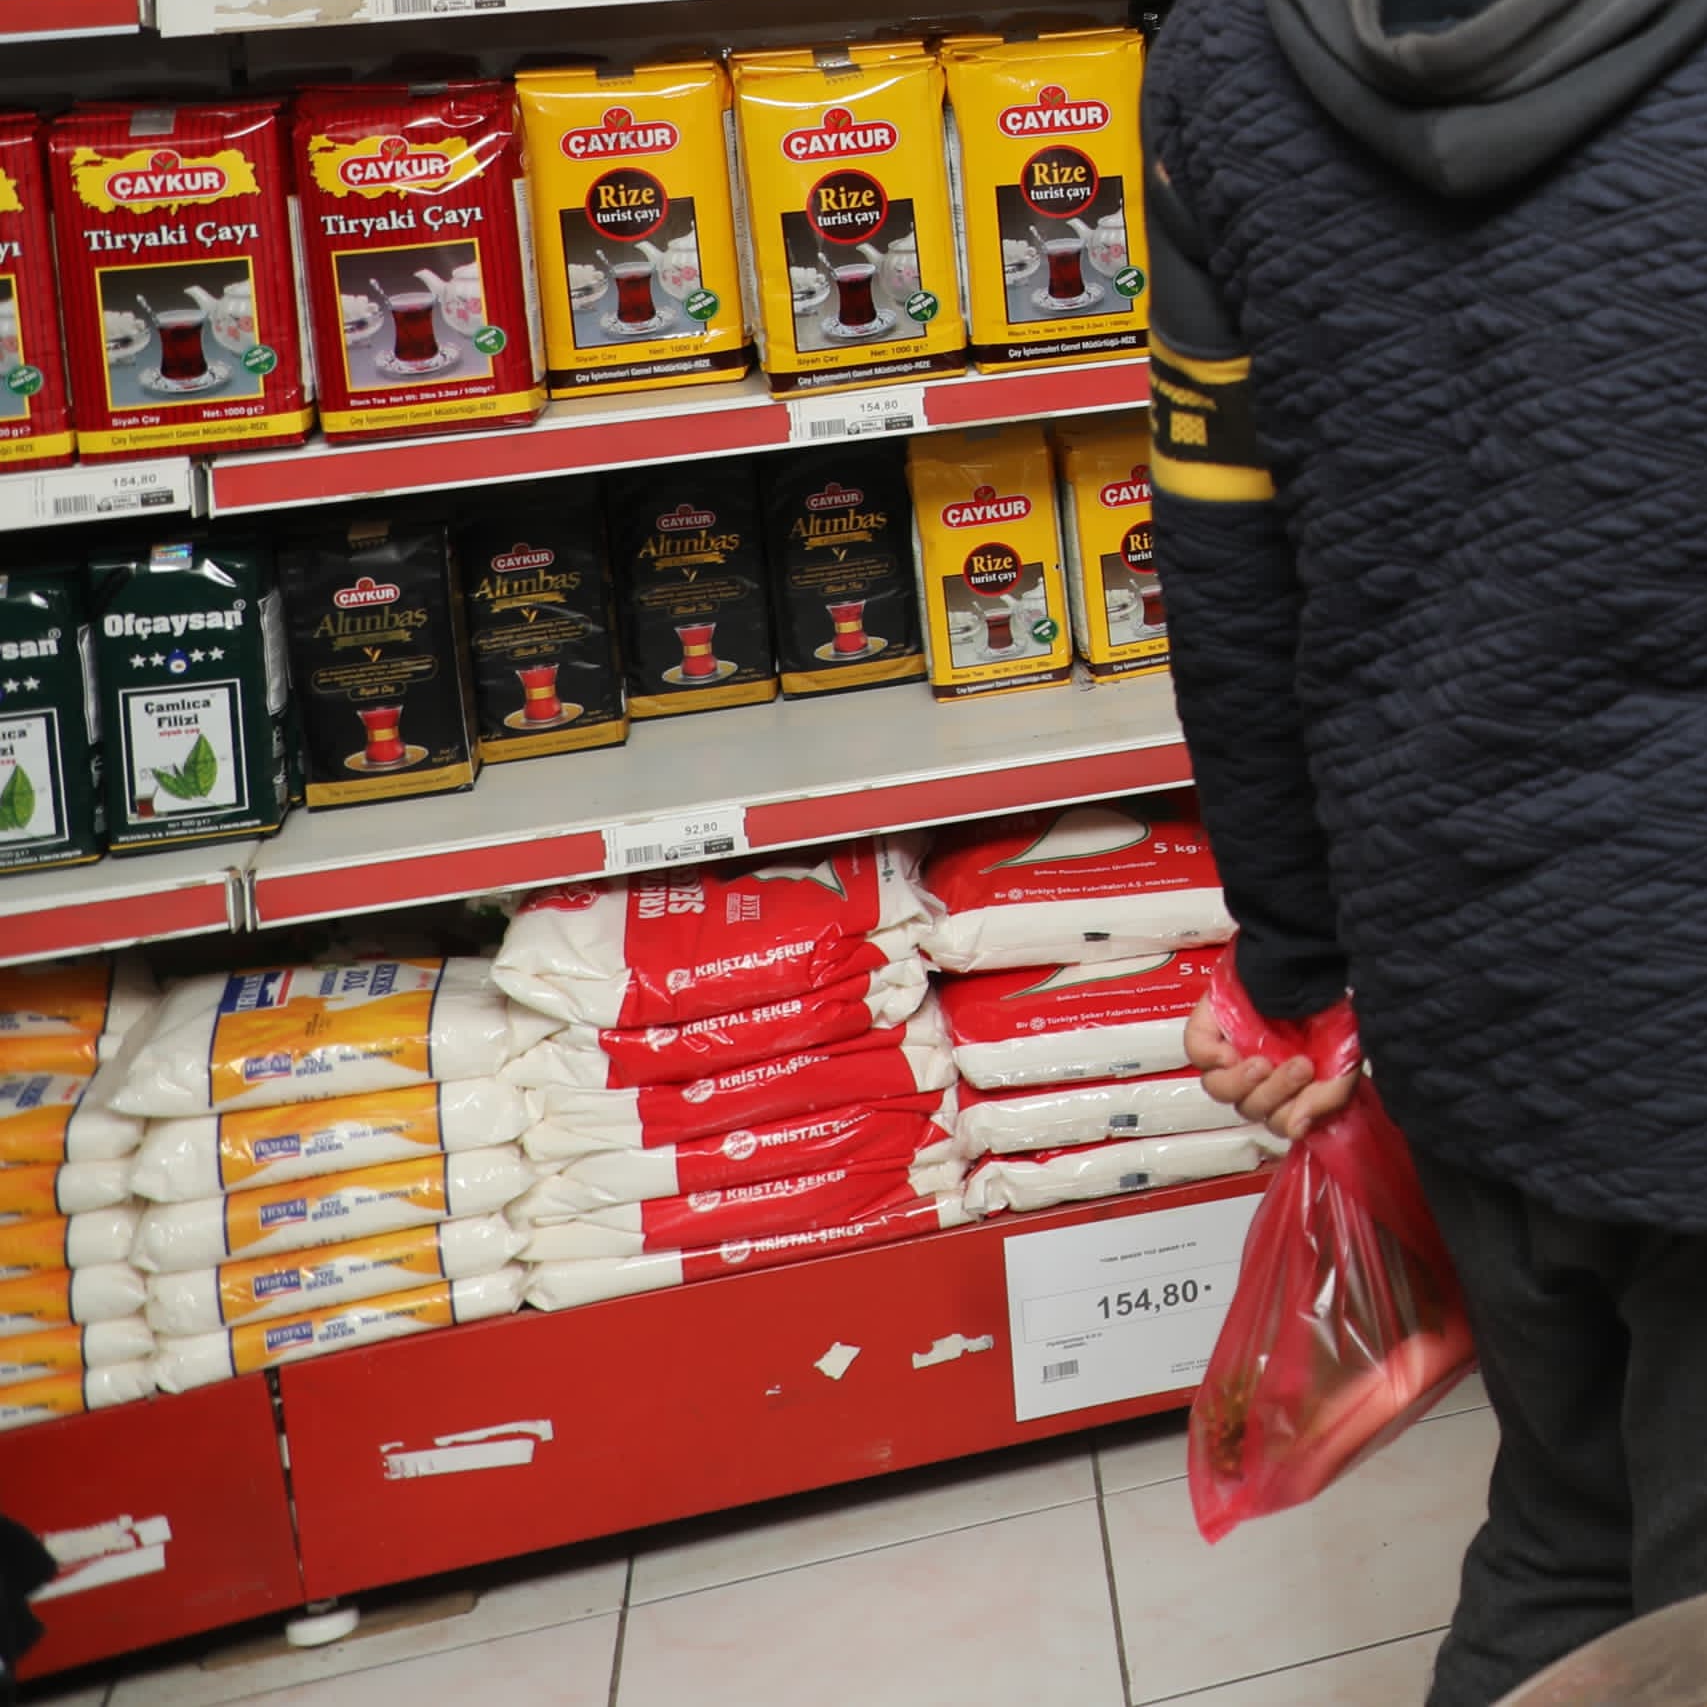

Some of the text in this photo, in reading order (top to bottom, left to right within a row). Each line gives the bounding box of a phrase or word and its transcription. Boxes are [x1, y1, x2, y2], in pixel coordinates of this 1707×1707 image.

[1005, 107, 1104, 132] ÇAYKUR
[568, 128, 672, 155] ÇAYKUR
[789, 128, 891, 155] ÇAYKUR
[1032, 161, 1087, 186] Rize
[598, 183, 656, 209] Rize
[818, 184, 876, 210] Rize
[1030, 184, 1092, 202] turist çayı
[321, 205, 483, 237] Tiryaki Çayı
[597, 208, 661, 228] turist çayı
[817, 210, 880, 229] turist çayı
[83, 221, 259, 254] Tiryaki Çayı
[859, 399, 899, 413] 154,80
[946, 499, 1028, 526] ÇAYKUR
[972, 554, 1013, 573] Rize
[474, 569, 582, 597] Altınbaş
[970, 570, 1017, 584] turist çayı
[104, 609, 242, 639] Ofçaysan
[313, 606, 429, 639] Altınbaş
[144, 696, 212, 717] Çamlıca
[156, 715, 201, 730] Filizi
[683, 822, 719, 835] 92,80
[1154, 843, 1197, 855] 5 kg
[694, 940, 815, 979] KRİSTAL ŞEKER
[681, 999, 803, 1038] KRİSTAL ŞEKER
[719, 1062, 787, 1090] KRİSTAL
[760, 1123, 834, 1149] KRİSTAL
[726, 1170, 847, 1200] KRİSTAL ŞEKER
[1095, 1278, 1199, 1322] 154,80
